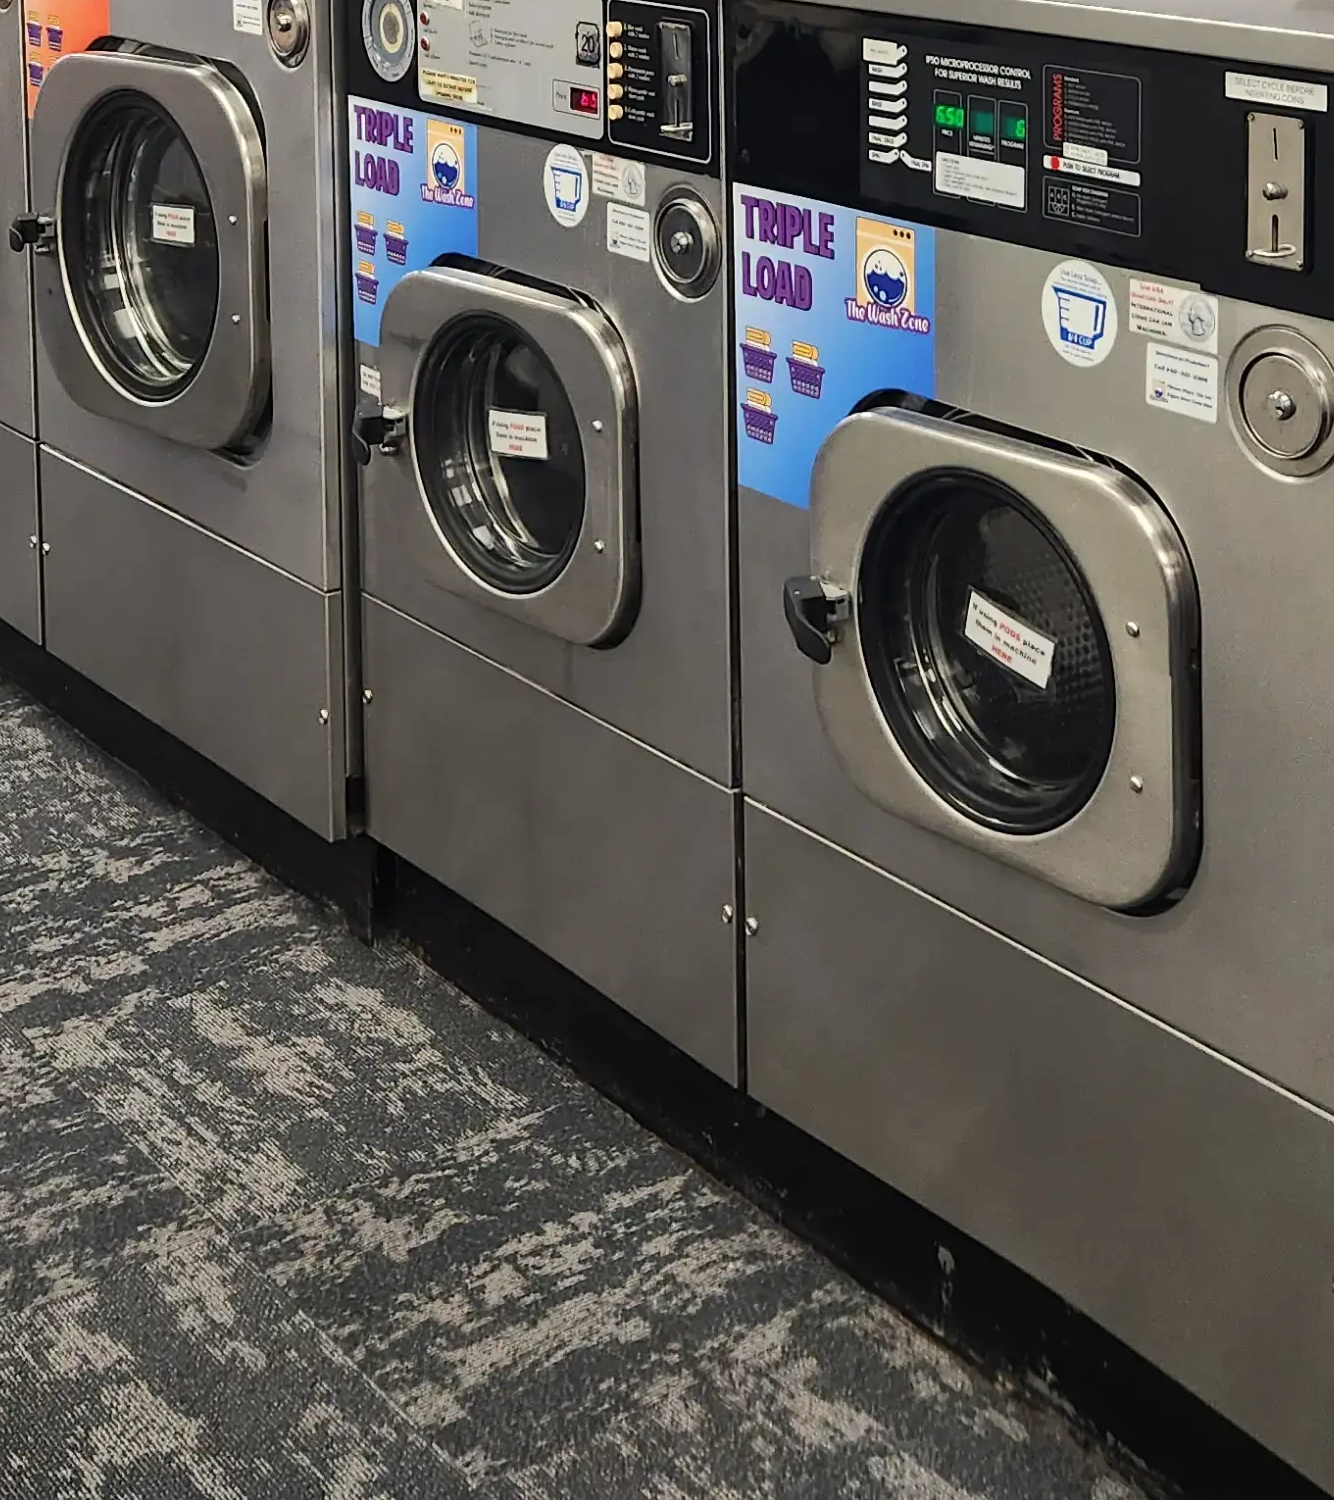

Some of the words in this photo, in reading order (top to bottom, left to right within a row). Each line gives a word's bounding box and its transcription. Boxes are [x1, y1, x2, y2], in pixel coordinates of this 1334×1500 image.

[354, 104, 414, 154] TRIPLE
[1052, 73, 1063, 140] PROGRAMS
[354, 150, 400, 196] LOAD
[740, 194, 835, 261] TRIPLE
[741, 251, 813, 311] LOAD
[846, 299, 866, 321] The
[867, 304, 900, 326] Wash
[900, 308, 930, 334] Zone
[975, 619, 993, 637] them
[1003, 640, 1037, 665] machine
[979, 609, 998, 627] using
[1000, 622, 1021, 641] PODS
[1022, 639, 1045, 657] place
[991, 644, 1012, 664] HERE
